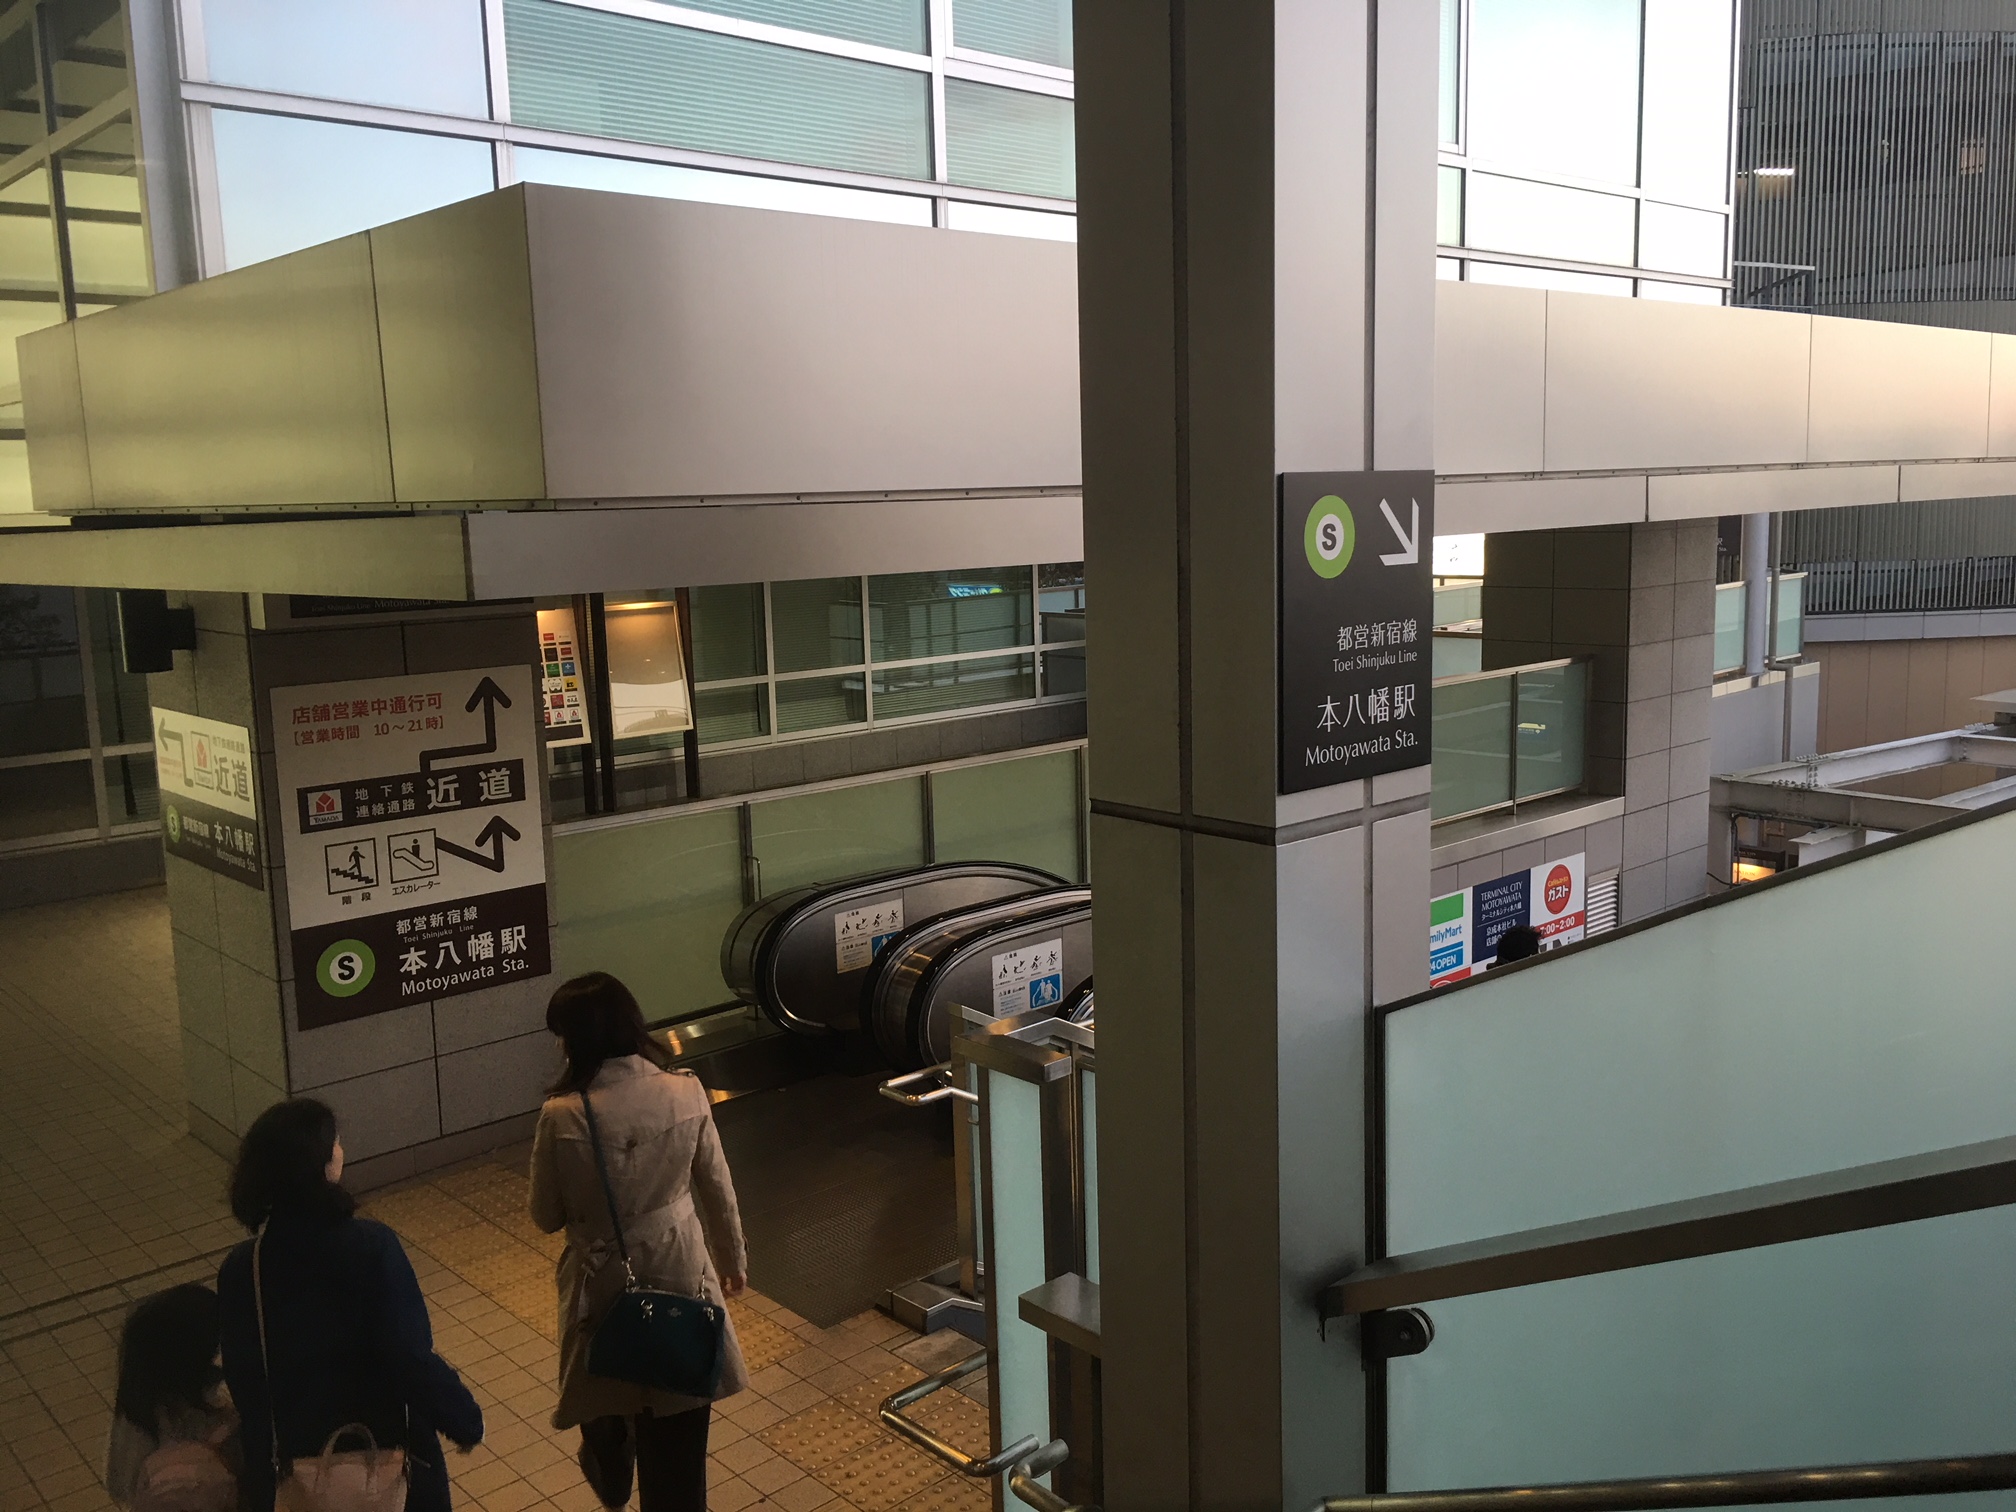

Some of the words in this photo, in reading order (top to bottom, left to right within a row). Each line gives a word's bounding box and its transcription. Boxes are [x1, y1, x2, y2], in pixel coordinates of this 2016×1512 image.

[1321, 523, 1337, 551] S
[1336, 618, 1418, 652] 都営新宿線
[1332, 658, 1354, 673] Toei
[1356, 652, 1396, 672] Shinjuku
[1398, 650, 1418, 665] Line
[291, 692, 444, 726] 店舗営業中通行可
[1316, 683, 1416, 734] 本八幡駅
[1304, 734, 1392, 767] Motoyawata
[1394, 729, 1419, 748] Sta.
[214, 755, 250, 802] 近道
[354, 781, 415, 801] 地下鉄
[426, 767, 513, 810] 近道
[355, 798, 416, 818] 連絡通路
[214, 821, 256, 857] 本八幡駅
[341, 892, 373, 906] 階段
[391, 880, 441, 897] エスカレーター
[1480, 886, 1509, 902] TERMINAL
[1510, 881, 1523, 892] CITY
[1548, 885, 1569, 902] ガスト
[1481, 892, 1522, 912] MOTOYAWATA
[395, 905, 479, 936] 都営新宿線
[403, 933, 419, 944] Toei
[422, 928, 454, 941] Shinjuku
[459, 923, 475, 933] Line
[1486, 918, 1517, 936] 京成本社ビル
[399, 924, 527, 976] 本八幡駅
[1486, 932, 1506, 947] 店舗の
[337, 955, 356, 981] S
[401, 964, 495, 996] Motoyawata
[502, 958, 529, 974] Sta.
